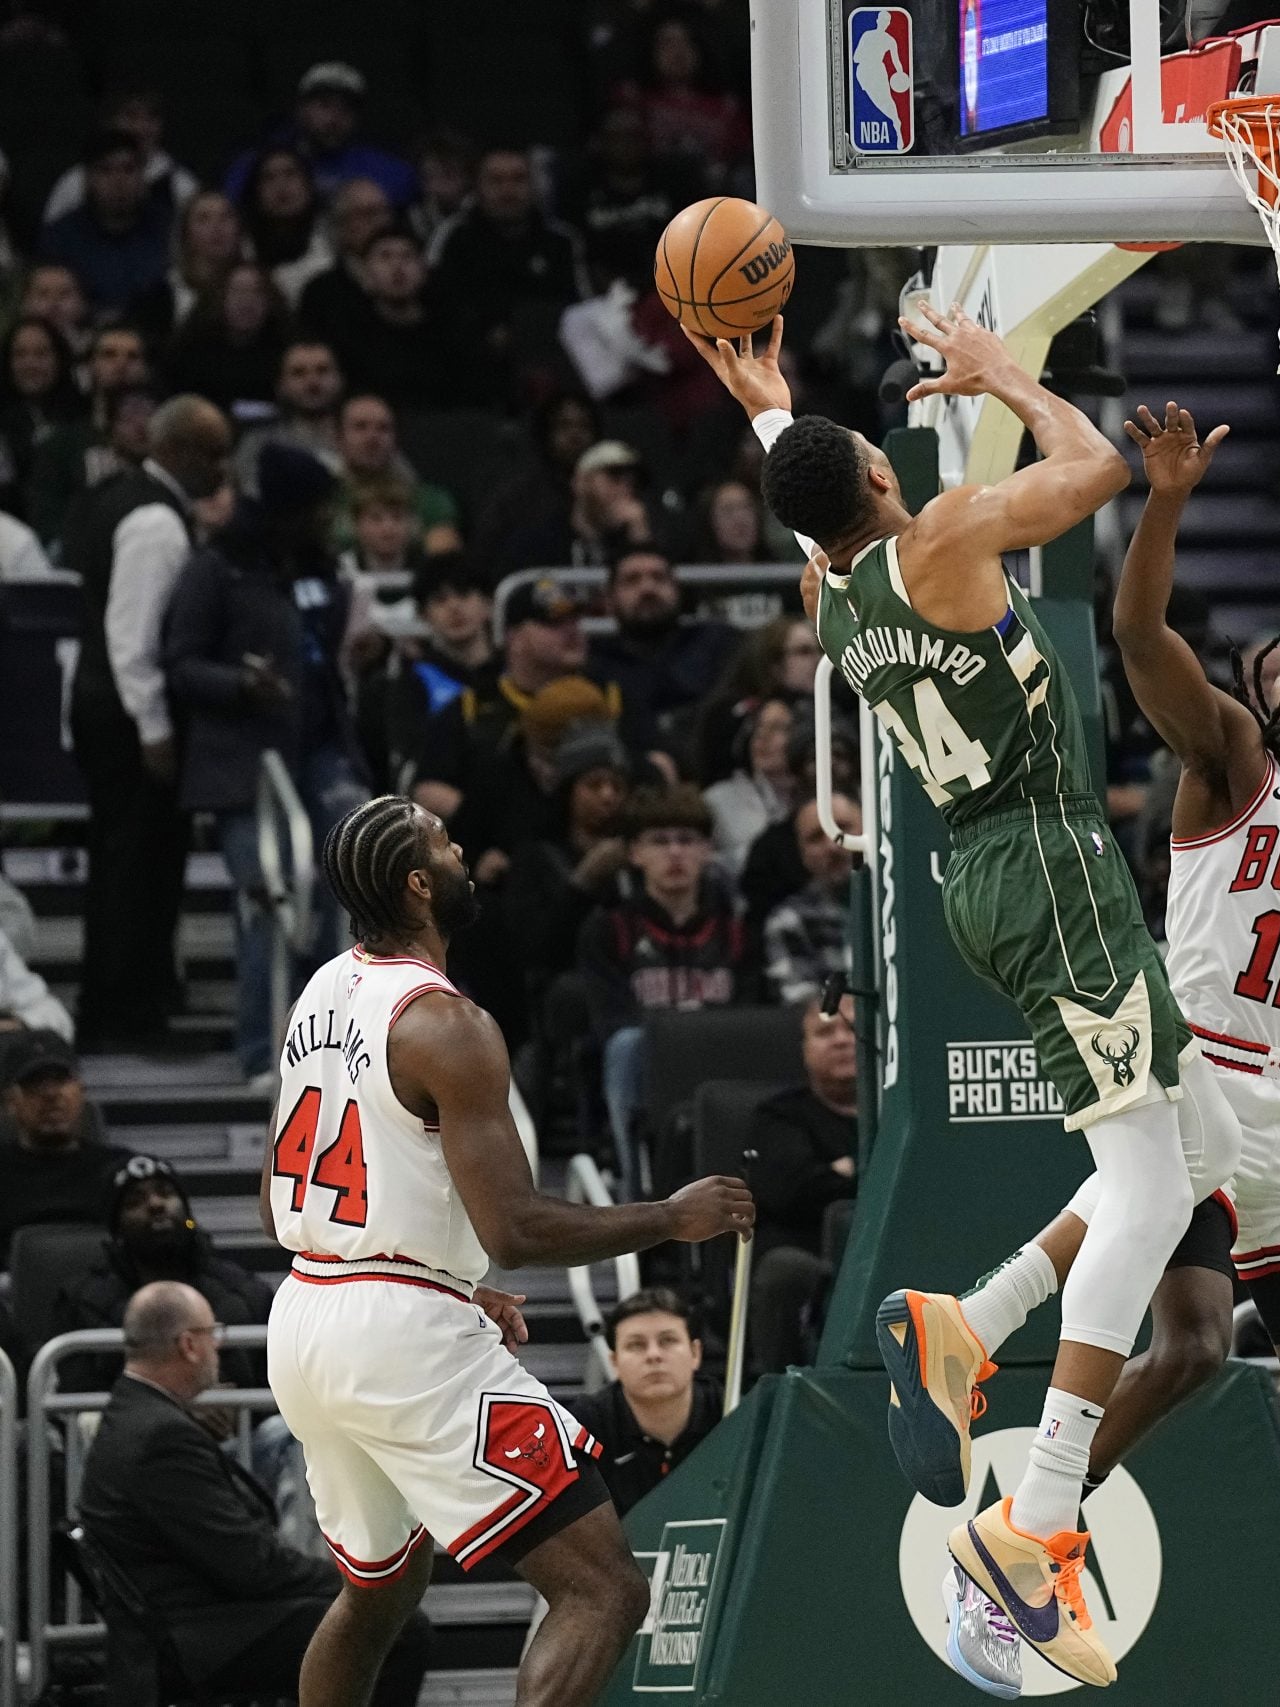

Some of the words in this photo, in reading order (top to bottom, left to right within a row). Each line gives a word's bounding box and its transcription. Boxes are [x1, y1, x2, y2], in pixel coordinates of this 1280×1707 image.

[860, 121, 890, 144] NBA
[738, 237, 791, 285] Wilso
[841, 626, 987, 697] TOKOUNMPO
[872, 676, 992, 808] 34
[878, 716, 898, 1090] betway
[286, 1009, 371, 1085] WILLAMS
[947, 1047, 1038, 1081] BUCKS
[948, 1082, 1002, 1115] PRO
[1010, 1080, 1066, 1114] SHO
[272, 1085, 368, 1229] 44
[649, 1620, 701, 1666] WISCONSIN
